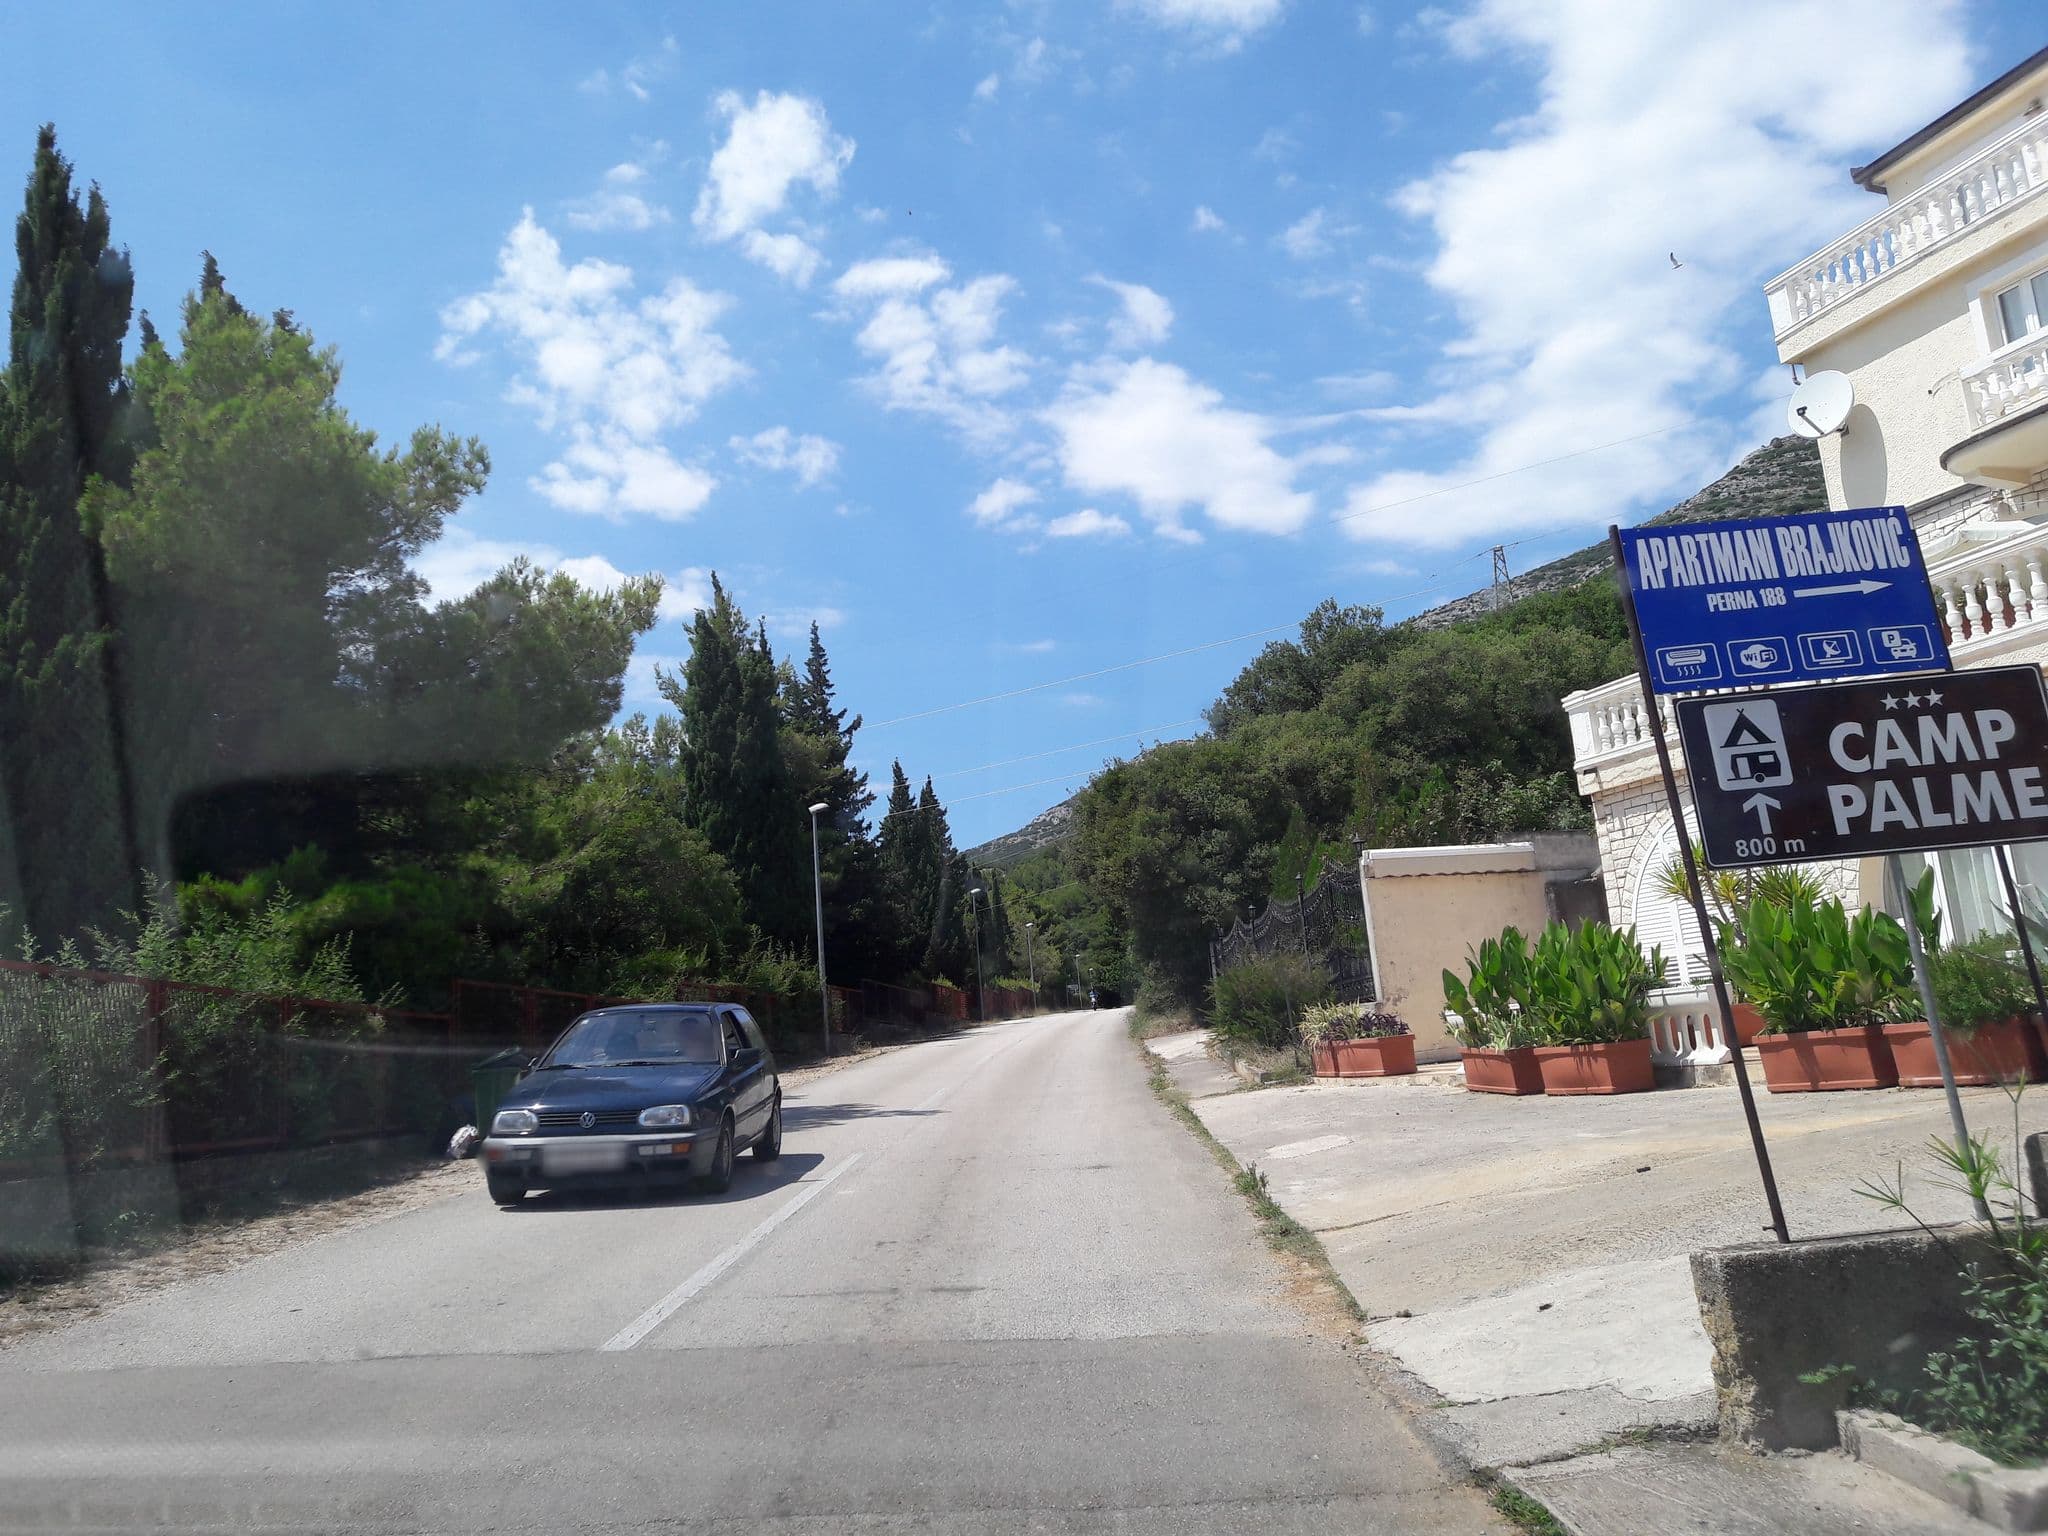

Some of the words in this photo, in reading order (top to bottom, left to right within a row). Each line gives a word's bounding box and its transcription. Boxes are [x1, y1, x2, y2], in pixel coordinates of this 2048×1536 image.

[1636, 528, 1780, 590] APARTMANI
[1707, 590, 1760, 613] PERNA
[1759, 587, 1787, 607] 188
[1828, 709, 2016, 773] CAMP
[1826, 766, 2048, 836] PALME
[1735, 836, 1777, 857] 800
[1783, 838, 1806, 854] m
